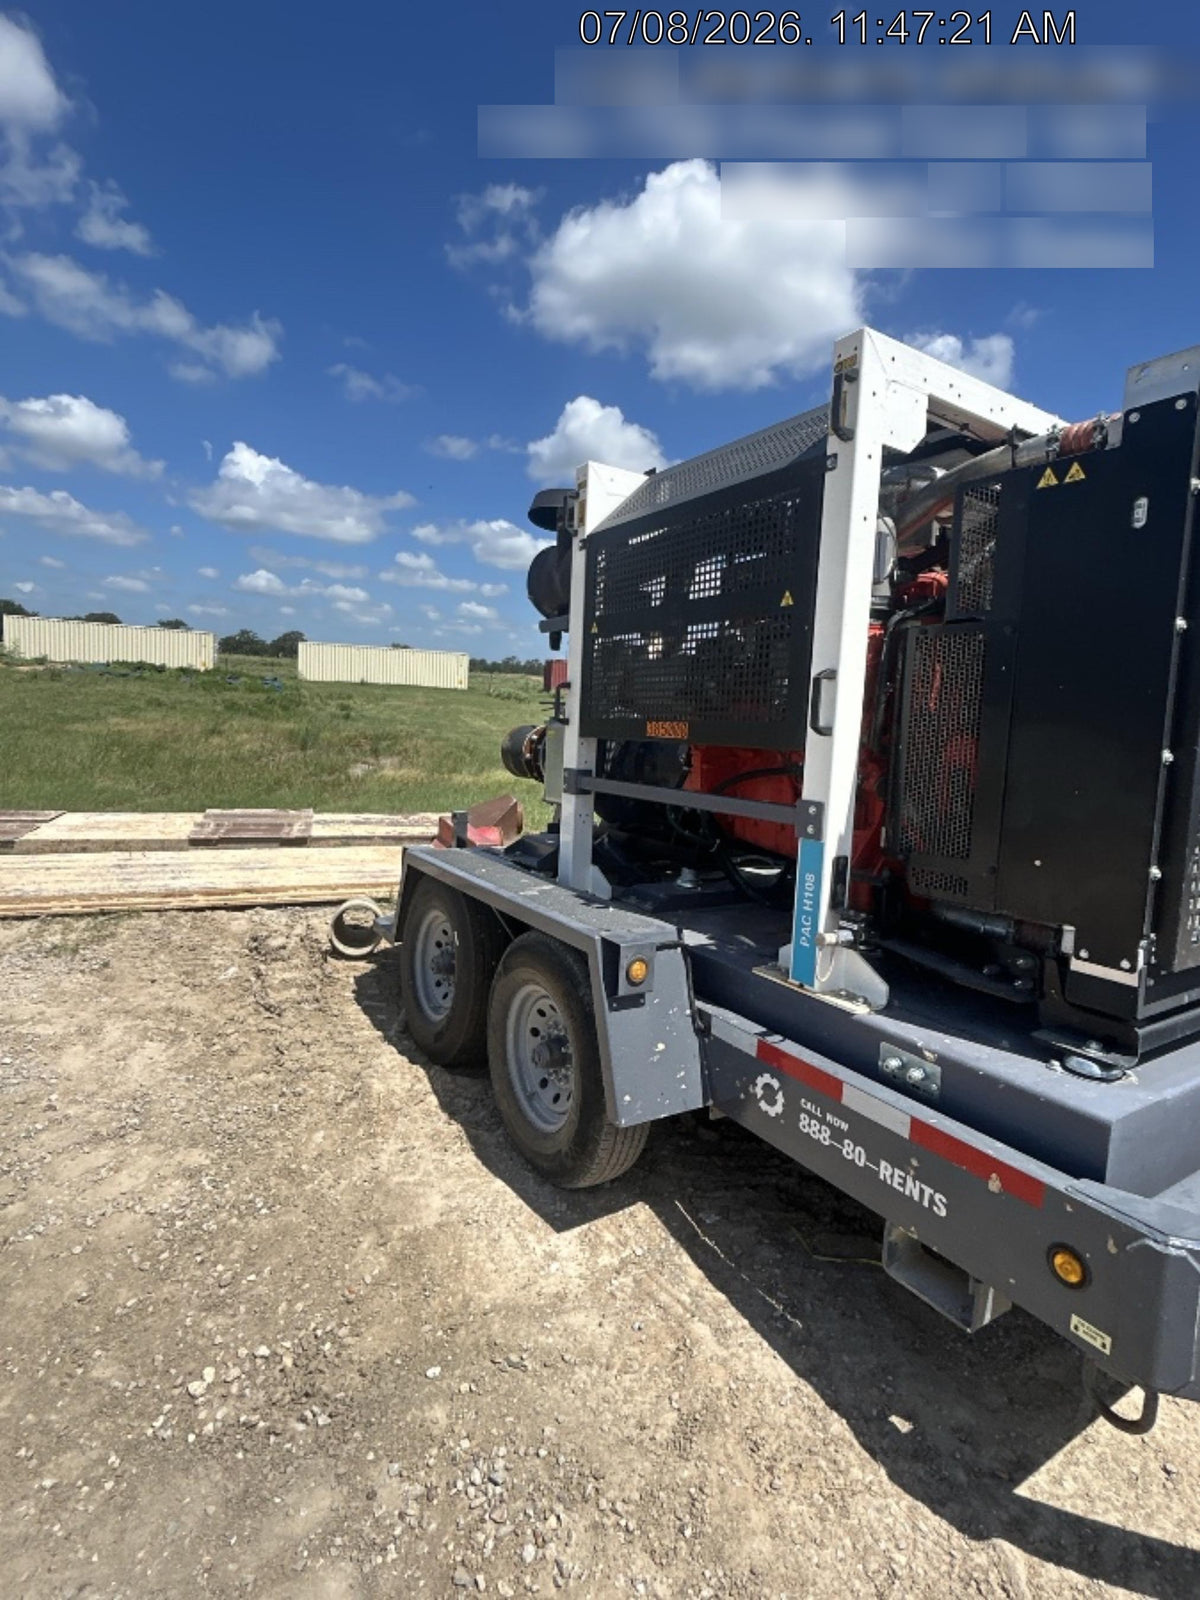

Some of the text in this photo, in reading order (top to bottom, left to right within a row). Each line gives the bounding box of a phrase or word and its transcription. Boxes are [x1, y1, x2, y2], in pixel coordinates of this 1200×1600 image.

[800, 873, 816, 949] PAC H108
[801, 1098, 849, 1132] CALL NOW
[799, 1112, 948, 1217] 888-80-RENTS
